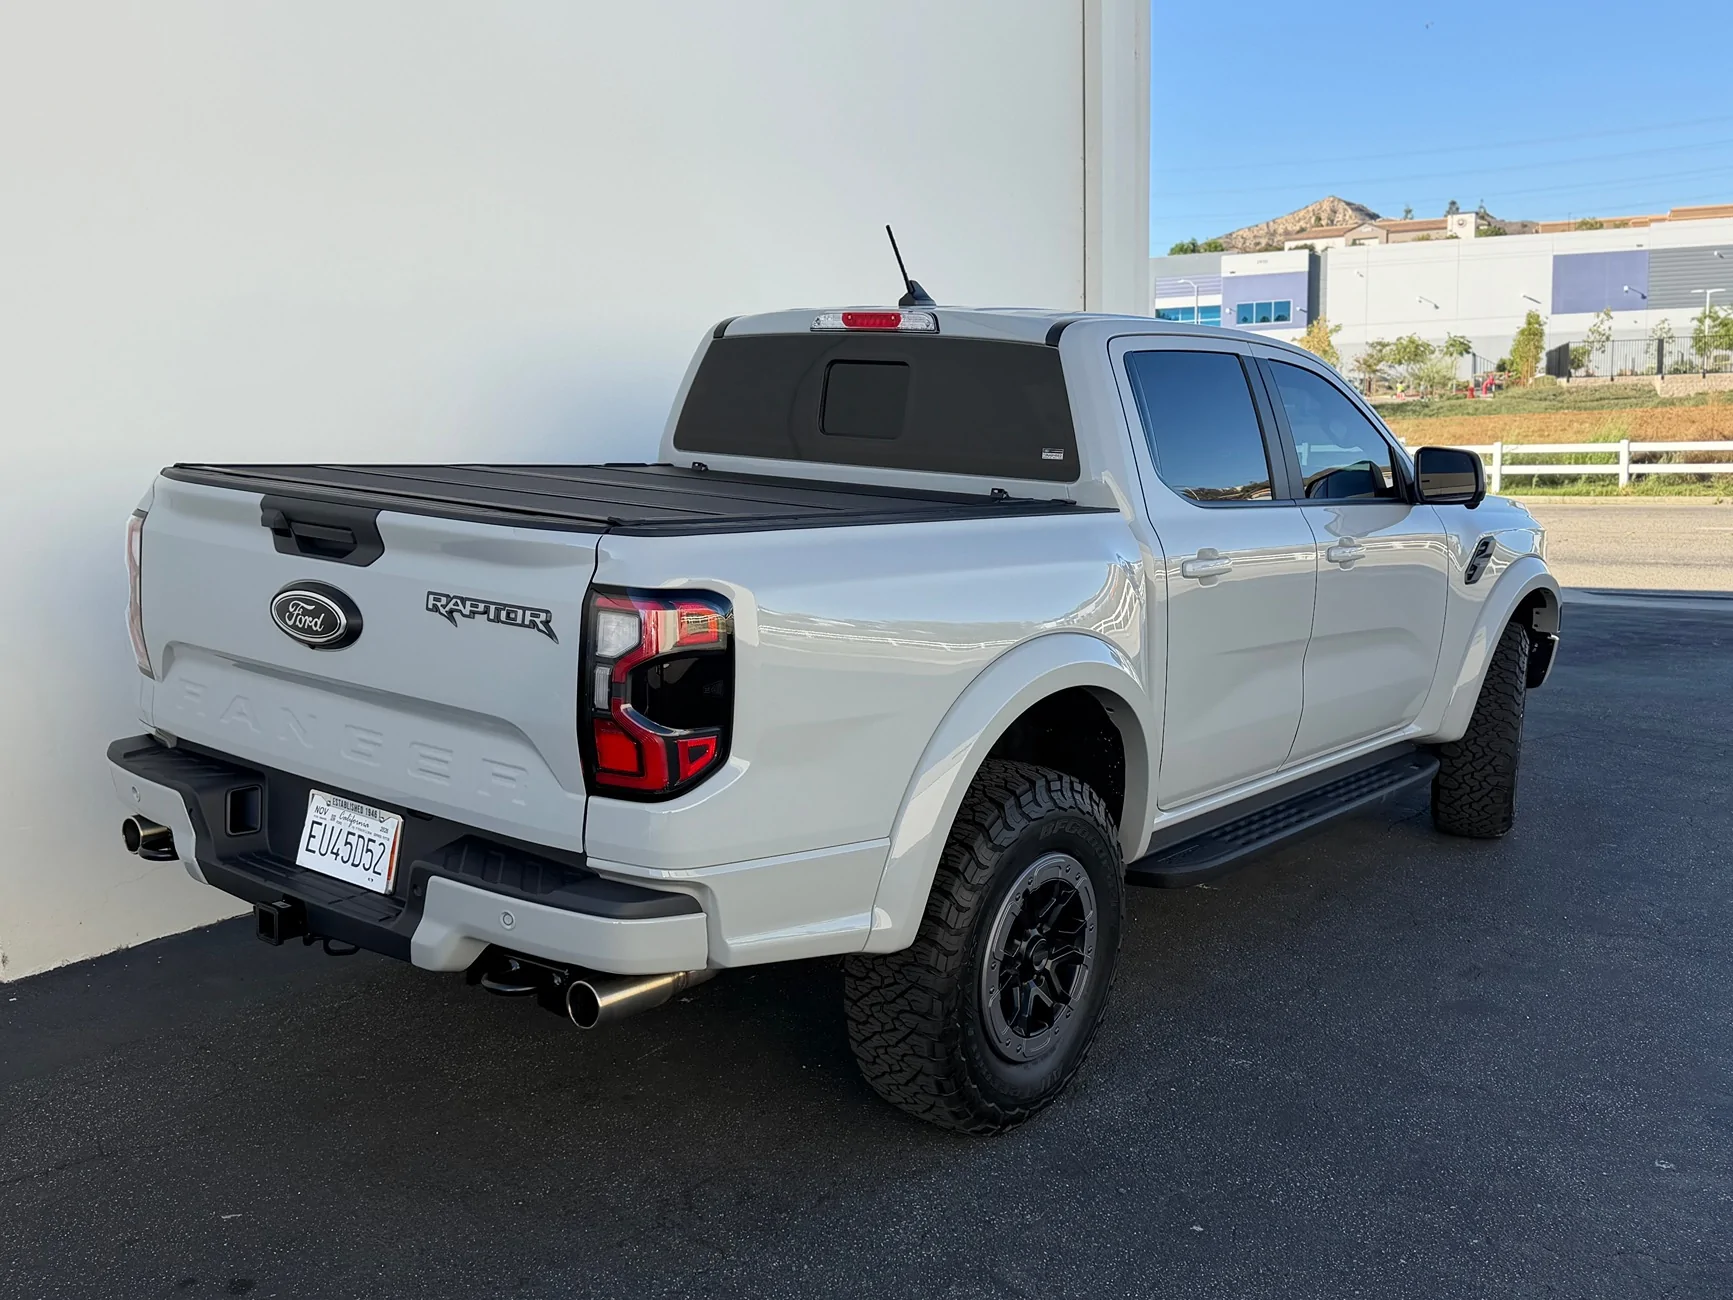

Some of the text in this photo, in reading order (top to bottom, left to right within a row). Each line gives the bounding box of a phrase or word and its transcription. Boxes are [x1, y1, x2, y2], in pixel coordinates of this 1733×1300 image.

[285, 600, 325, 632] Ford
[426, 590, 559, 645] RAPTOR
[177, 677, 529, 806] RANGER
[314, 805, 329, 816] NOV
[332, 797, 365, 814] ESTABLISHED
[339, 810, 370, 828] California
[305, 820, 386, 876] EU45D52
